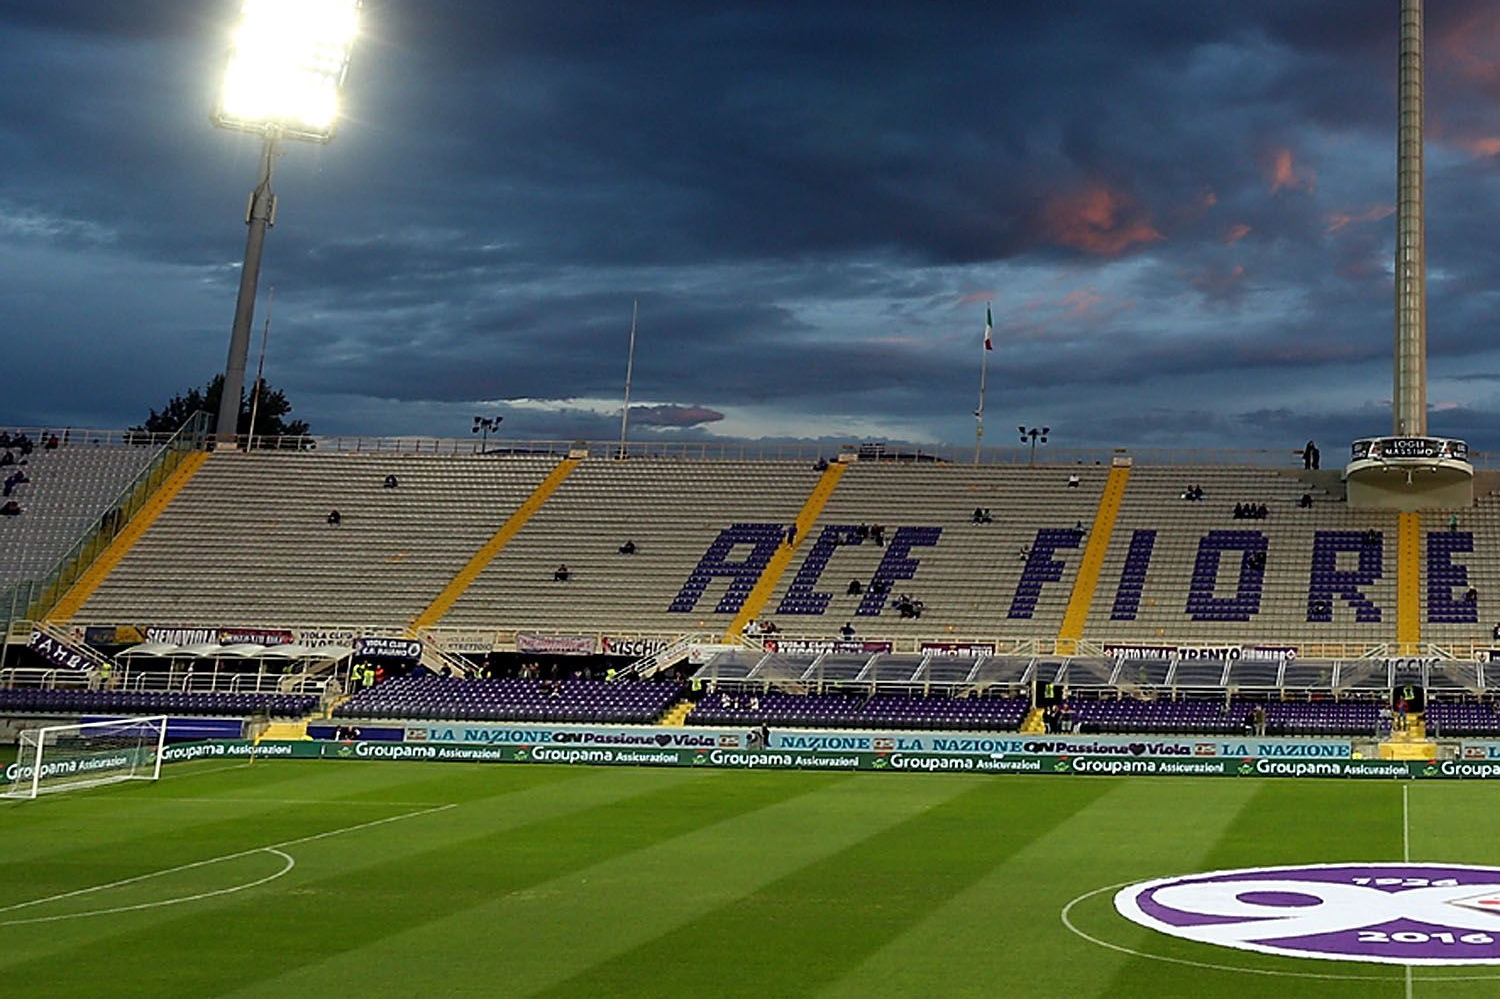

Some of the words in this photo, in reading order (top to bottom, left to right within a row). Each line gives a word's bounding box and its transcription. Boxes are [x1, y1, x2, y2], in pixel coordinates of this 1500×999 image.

[667, 523, 942, 617] ACF
[1179, 648, 1240, 660] TRENTO
[430, 729, 455, 740] LA
[464, 730, 551, 743] NAZIONE
[584, 733, 654, 745] Passione
[674, 735, 715, 746] Viola
[781, 736, 869, 749] NAZIONE
[162, 745, 224, 760] Groupama
[227, 744, 291, 755] Assicurazioni
[356, 742, 435, 759] Groupama
[439, 748, 501, 759] Assicurazioni
[897, 739, 923, 750] LA
[933, 739, 1023, 752] NAZIONE
[1055, 742, 1128, 754] Passione
[1148, 744, 1191, 756] Viola
[1222, 745, 1248, 756] LA
[1258, 745, 1349, 756] NAZIONE
[532, 746, 612, 764] Groupama
[616, 752, 678, 763] Assicurazioni
[710, 750, 792, 767] Groupama
[795, 756, 859, 766] Assicurazioni
[891, 754, 973, 770] Groupama
[976, 760, 1040, 770] Assicurazioni
[7, 761, 76, 780] Gropama
[1072, 756, 1155, 774] Groupama
[1159, 762, 1224, 772] Assicurazioni
[1257, 759, 1340, 775] Groupama
[1344, 765, 1408, 775] Assicurazioni
[1357, 931, 1495, 945] 2016
